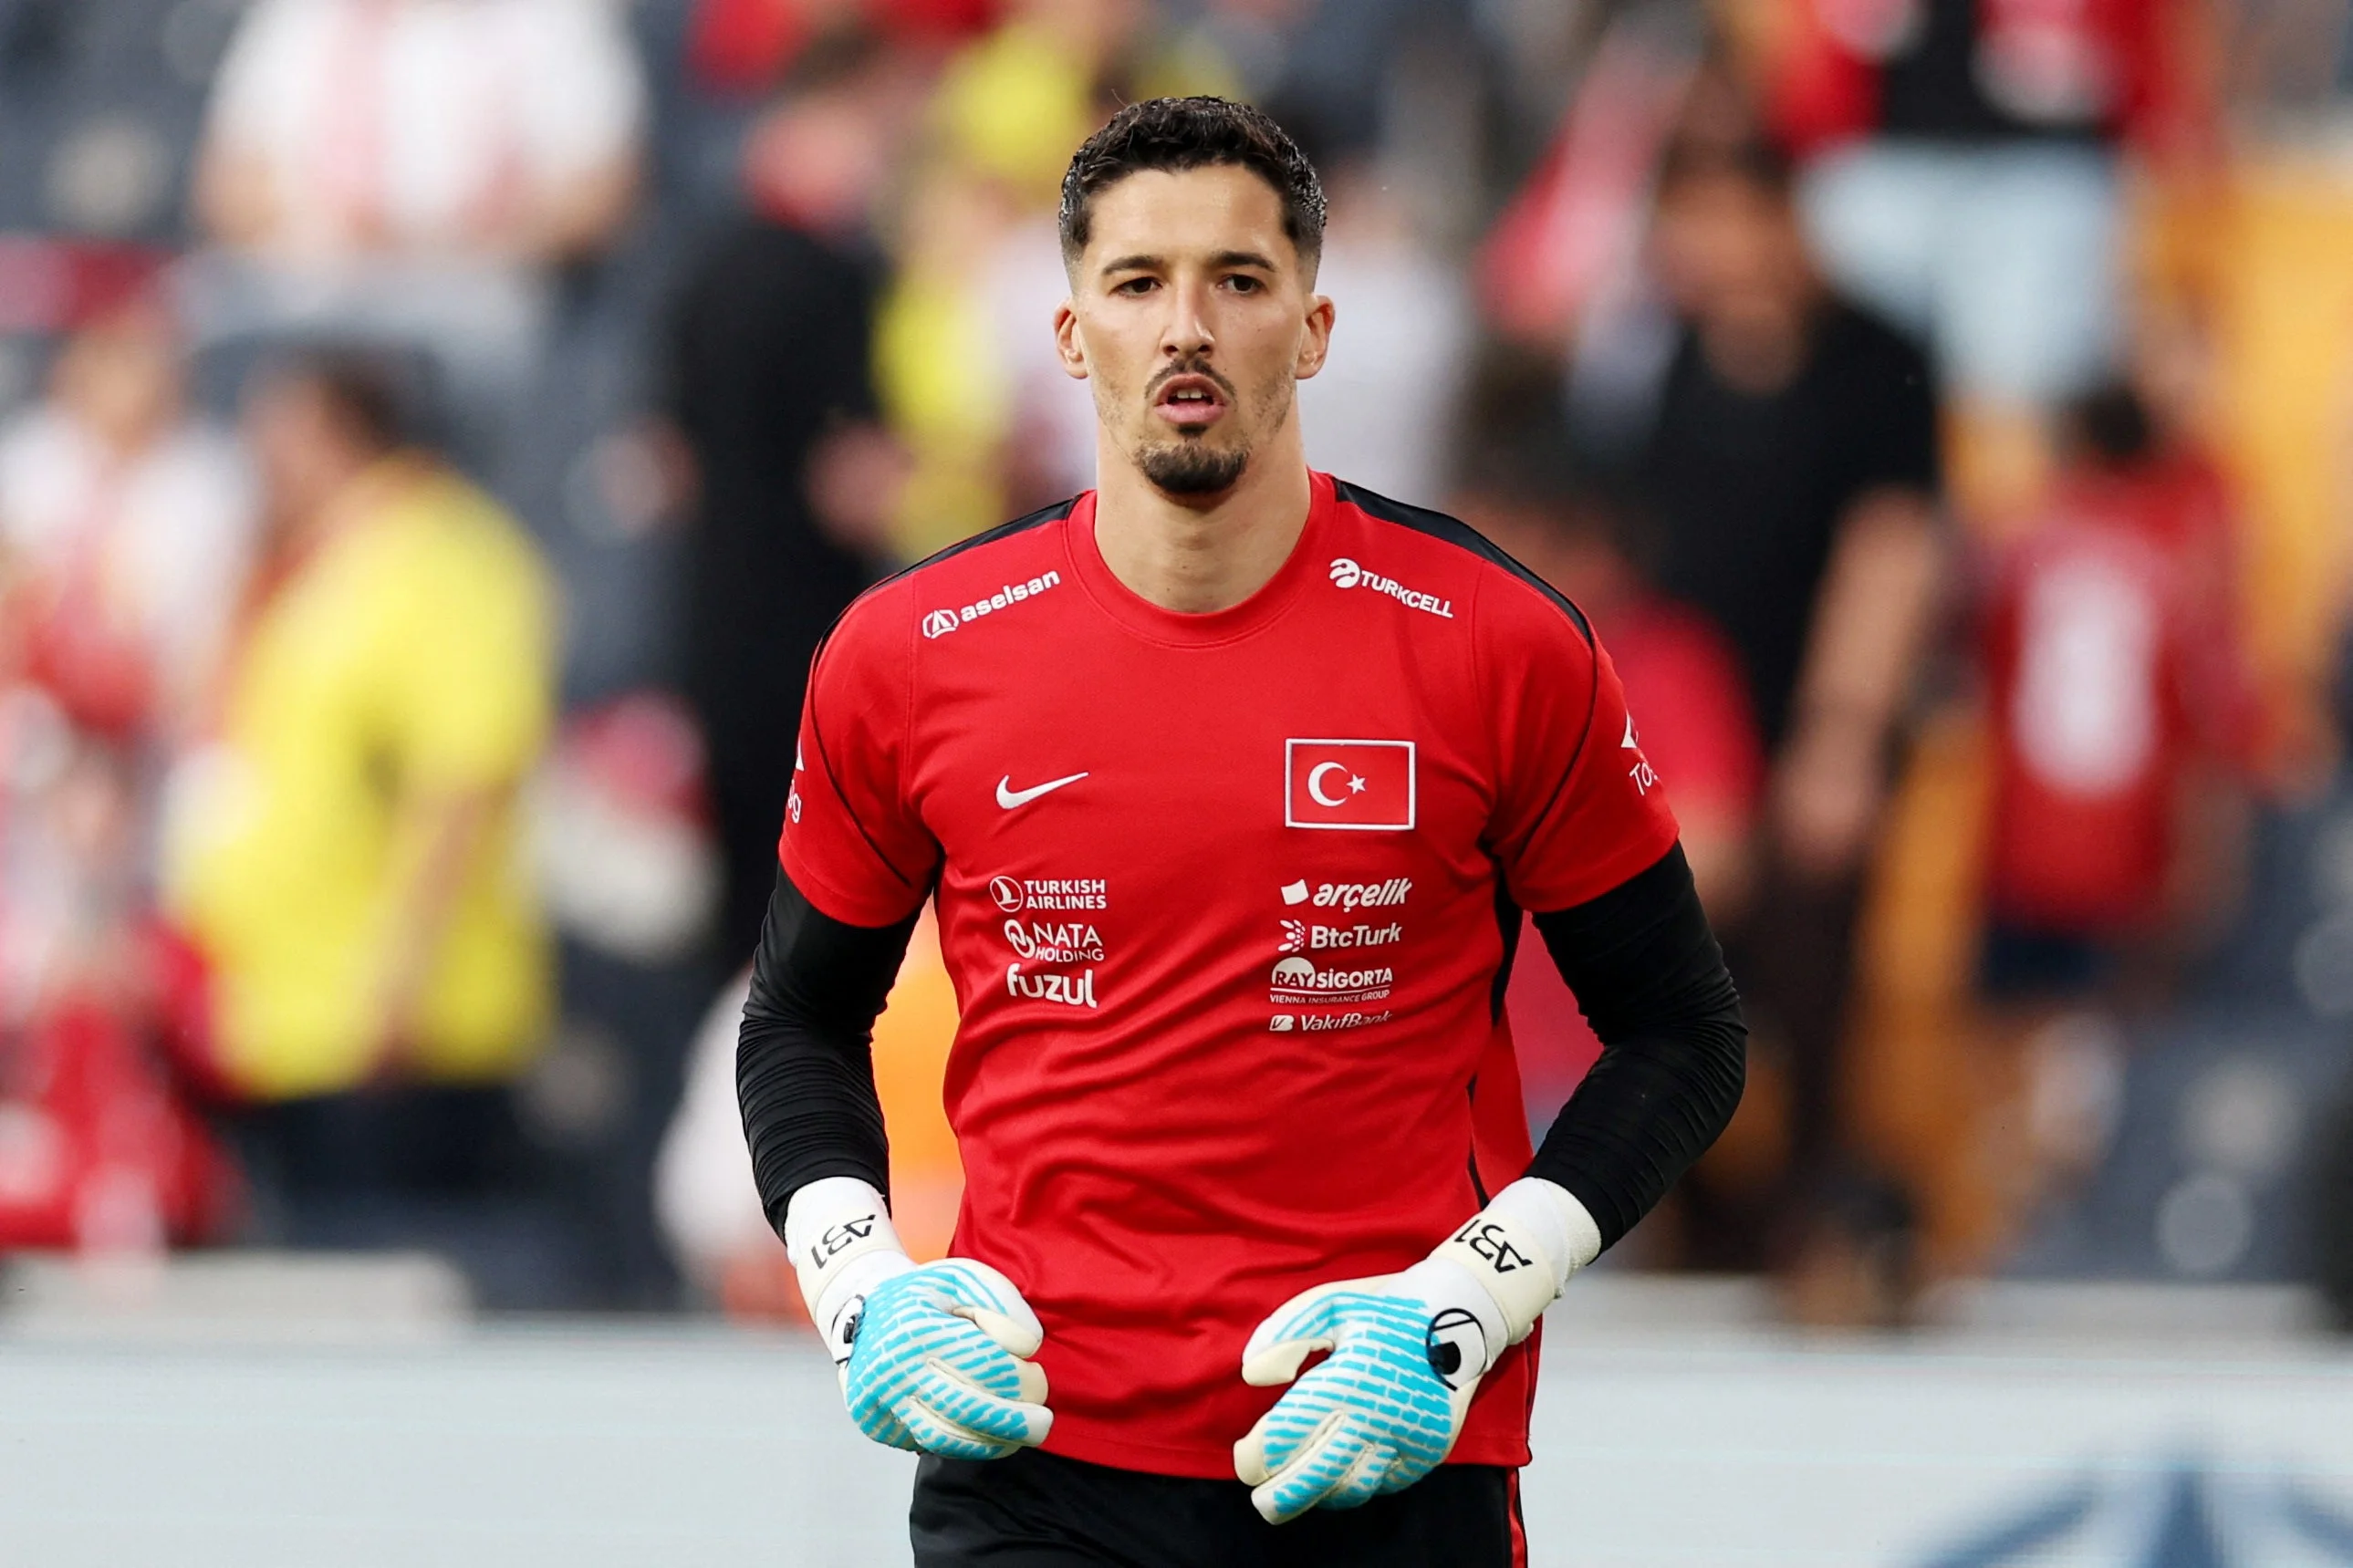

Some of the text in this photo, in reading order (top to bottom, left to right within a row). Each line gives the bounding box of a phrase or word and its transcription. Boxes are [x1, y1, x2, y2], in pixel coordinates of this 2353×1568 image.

[960, 570, 1060, 622] aselsan
[1361, 570, 1453, 618] TURKCELL
[1024, 879, 1106, 894] TURKISH
[1312, 877, 1412, 913] arçelik
[1026, 895, 1107, 909] AIRLINES
[1032, 922, 1103, 949] NATA
[1310, 922, 1402, 949] BtcTurk
[1035, 946, 1105, 962] HOLDING
[1006, 963, 1098, 1009] fuzul
[1269, 989, 1390, 1004] VIENNA INSURANCE GROUP
